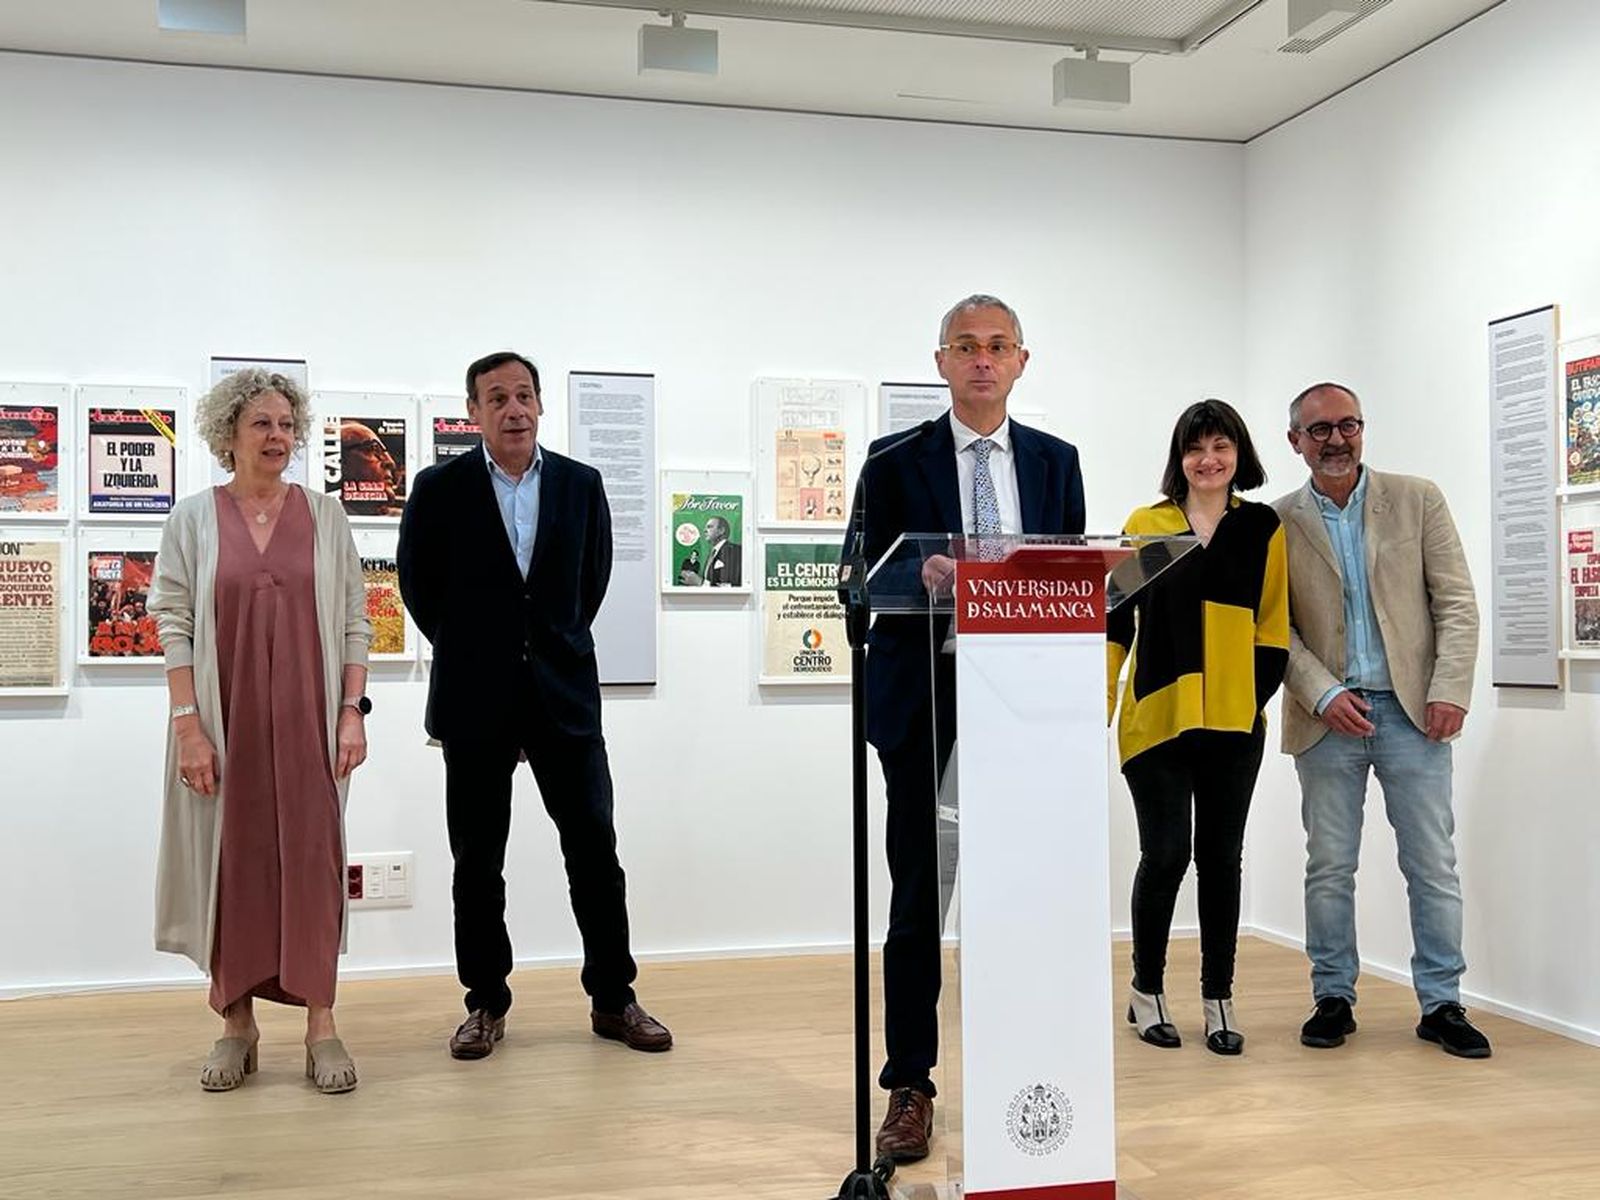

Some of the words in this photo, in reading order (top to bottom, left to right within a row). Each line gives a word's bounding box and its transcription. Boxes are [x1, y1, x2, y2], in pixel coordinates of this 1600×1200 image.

[1571, 379, 1581, 390] EL
[107, 442, 118, 456] EL
[120, 442, 155, 456] PODER
[325, 416, 342, 484] CALLE
[120, 458, 128, 472] Y
[129, 459, 143, 472] LA
[104, 473, 158, 489] IZQUIERDA
[343, 481, 357, 491] LA
[777, 563, 794, 577] EL
[795, 563, 838, 577] CENTR
[1571, 568, 1579, 584] EL
[767, 578, 779, 587] ES
[781, 578, 793, 587] LA
[795, 578, 839, 587] DEMOCRA
[0, 594, 53, 606] ENTE
[788, 594, 812, 602] Porque
[982, 601, 1095, 618] SALAMANCA
[793, 656, 832, 666] CENTRO
